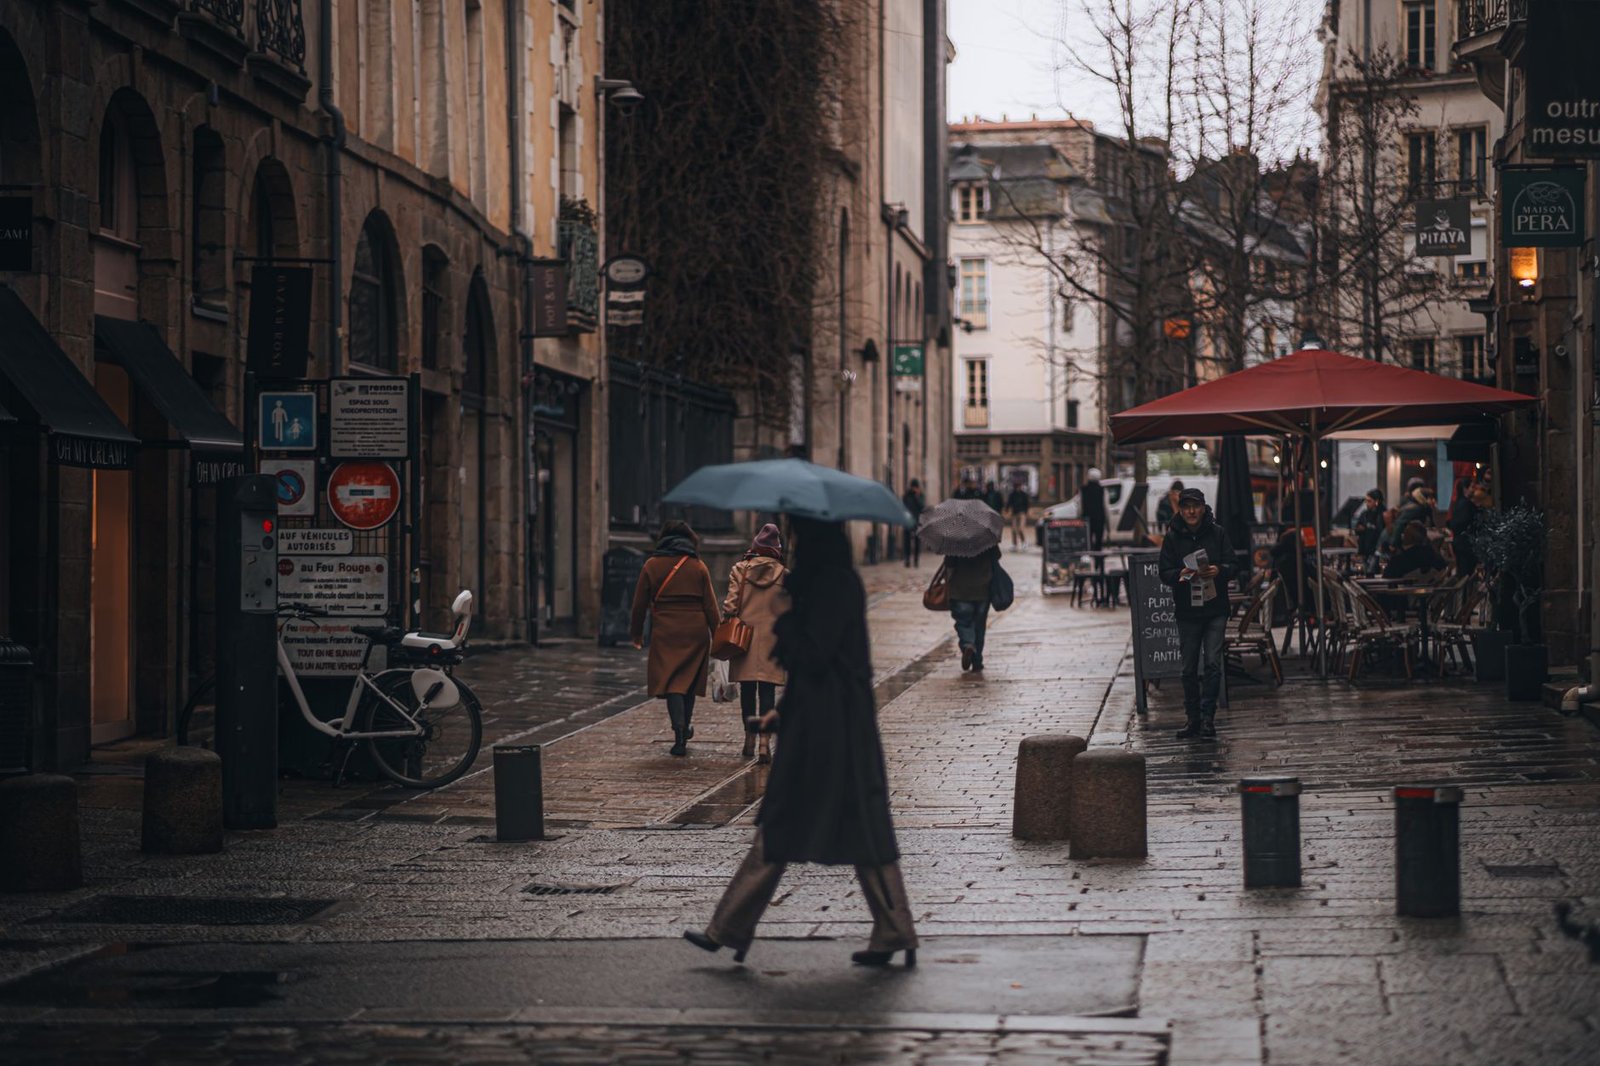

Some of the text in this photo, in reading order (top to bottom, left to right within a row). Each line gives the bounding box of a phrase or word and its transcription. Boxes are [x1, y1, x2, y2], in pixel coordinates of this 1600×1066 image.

[1546, 98, 1600, 119] outr
[1532, 128, 1600, 145] mesu
[1522, 205, 1565, 214] MAISON
[1517, 214, 1571, 231] PERA
[56, 439, 128, 465] OH MY CREAM!
[197, 461, 208, 484] OH
[209, 462, 222, 484] MY
[279, 530, 350, 541] AUF VÉHICULES
[287, 541, 337, 551] AUTORISÉS
[301, 564, 313, 572] au
[316, 562, 334, 572] Feu
[338, 562, 371, 574] Rouge
[287, 624, 298, 632] Feu
[297, 649, 314, 657] TOUT
[315, 662, 337, 670] AUTRE
